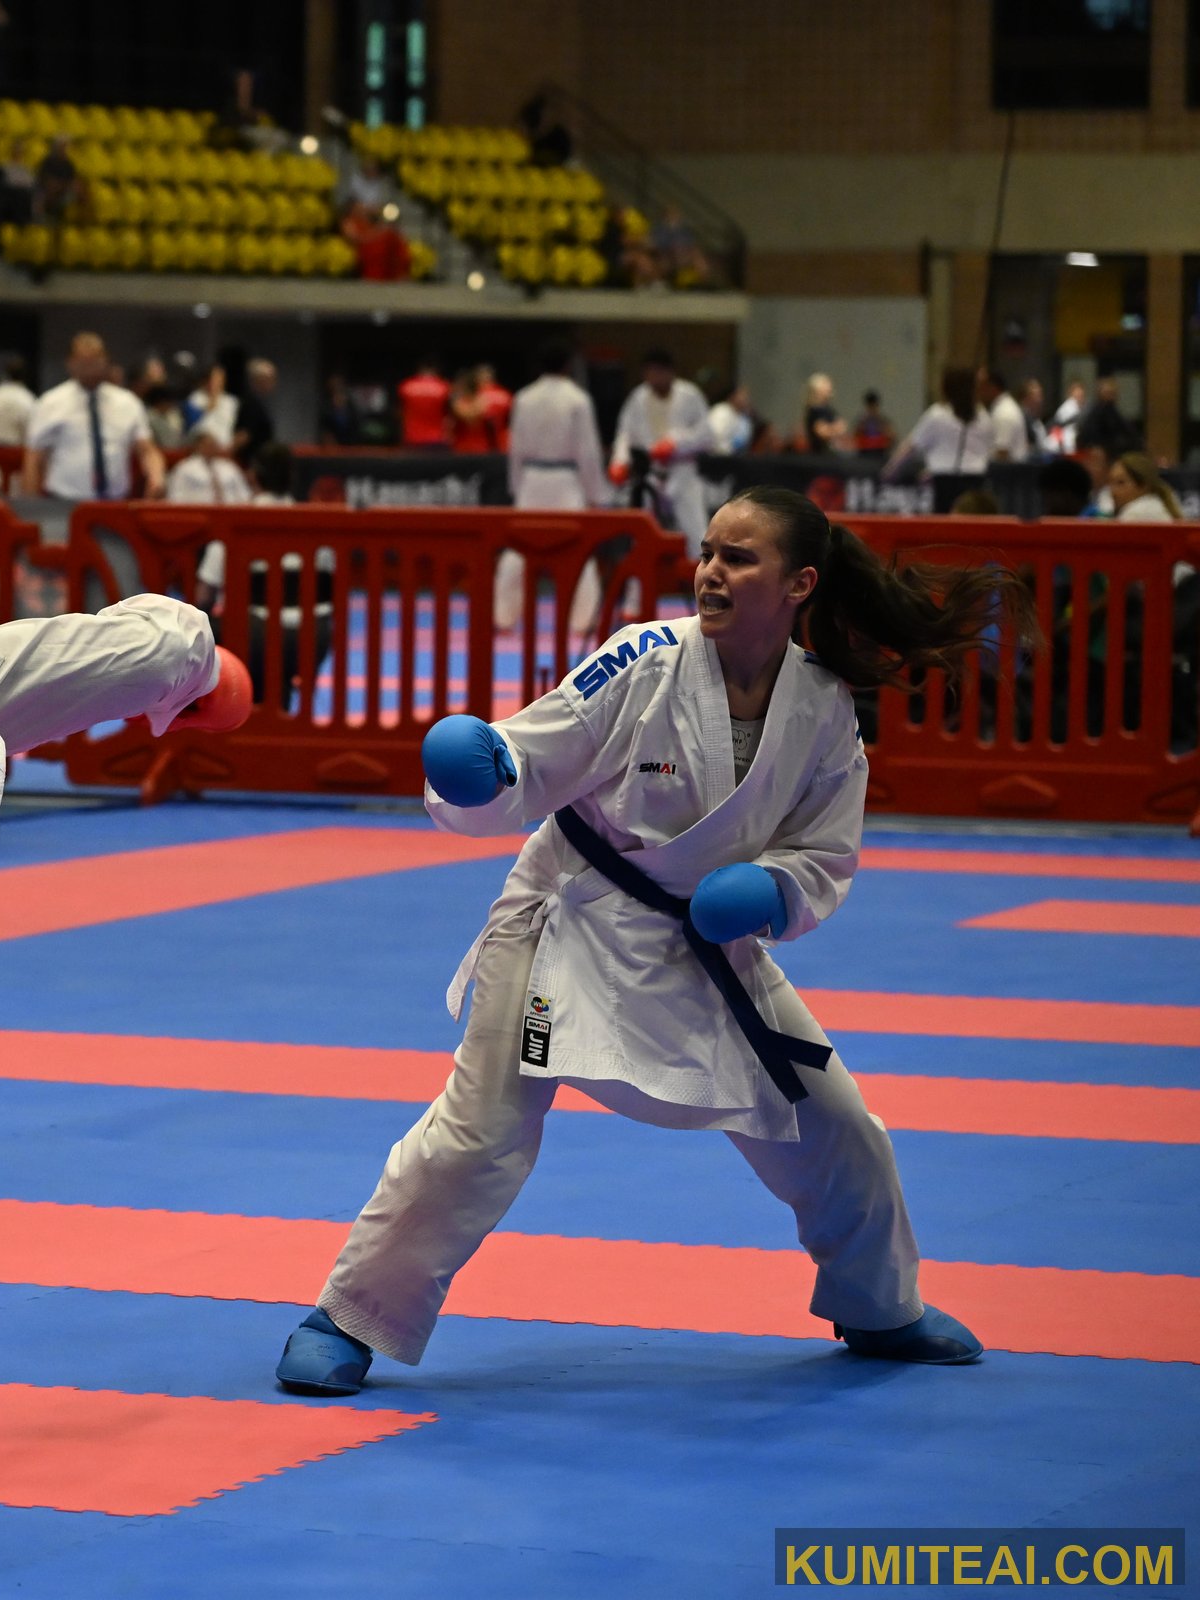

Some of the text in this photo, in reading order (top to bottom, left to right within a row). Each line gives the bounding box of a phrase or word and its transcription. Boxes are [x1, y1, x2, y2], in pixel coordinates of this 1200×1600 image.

[573, 626, 678, 701] SMAI
[639, 762, 676, 775] SMAI
[528, 1021, 548, 1031] SMAI
[528, 1033, 544, 1061] JIN
